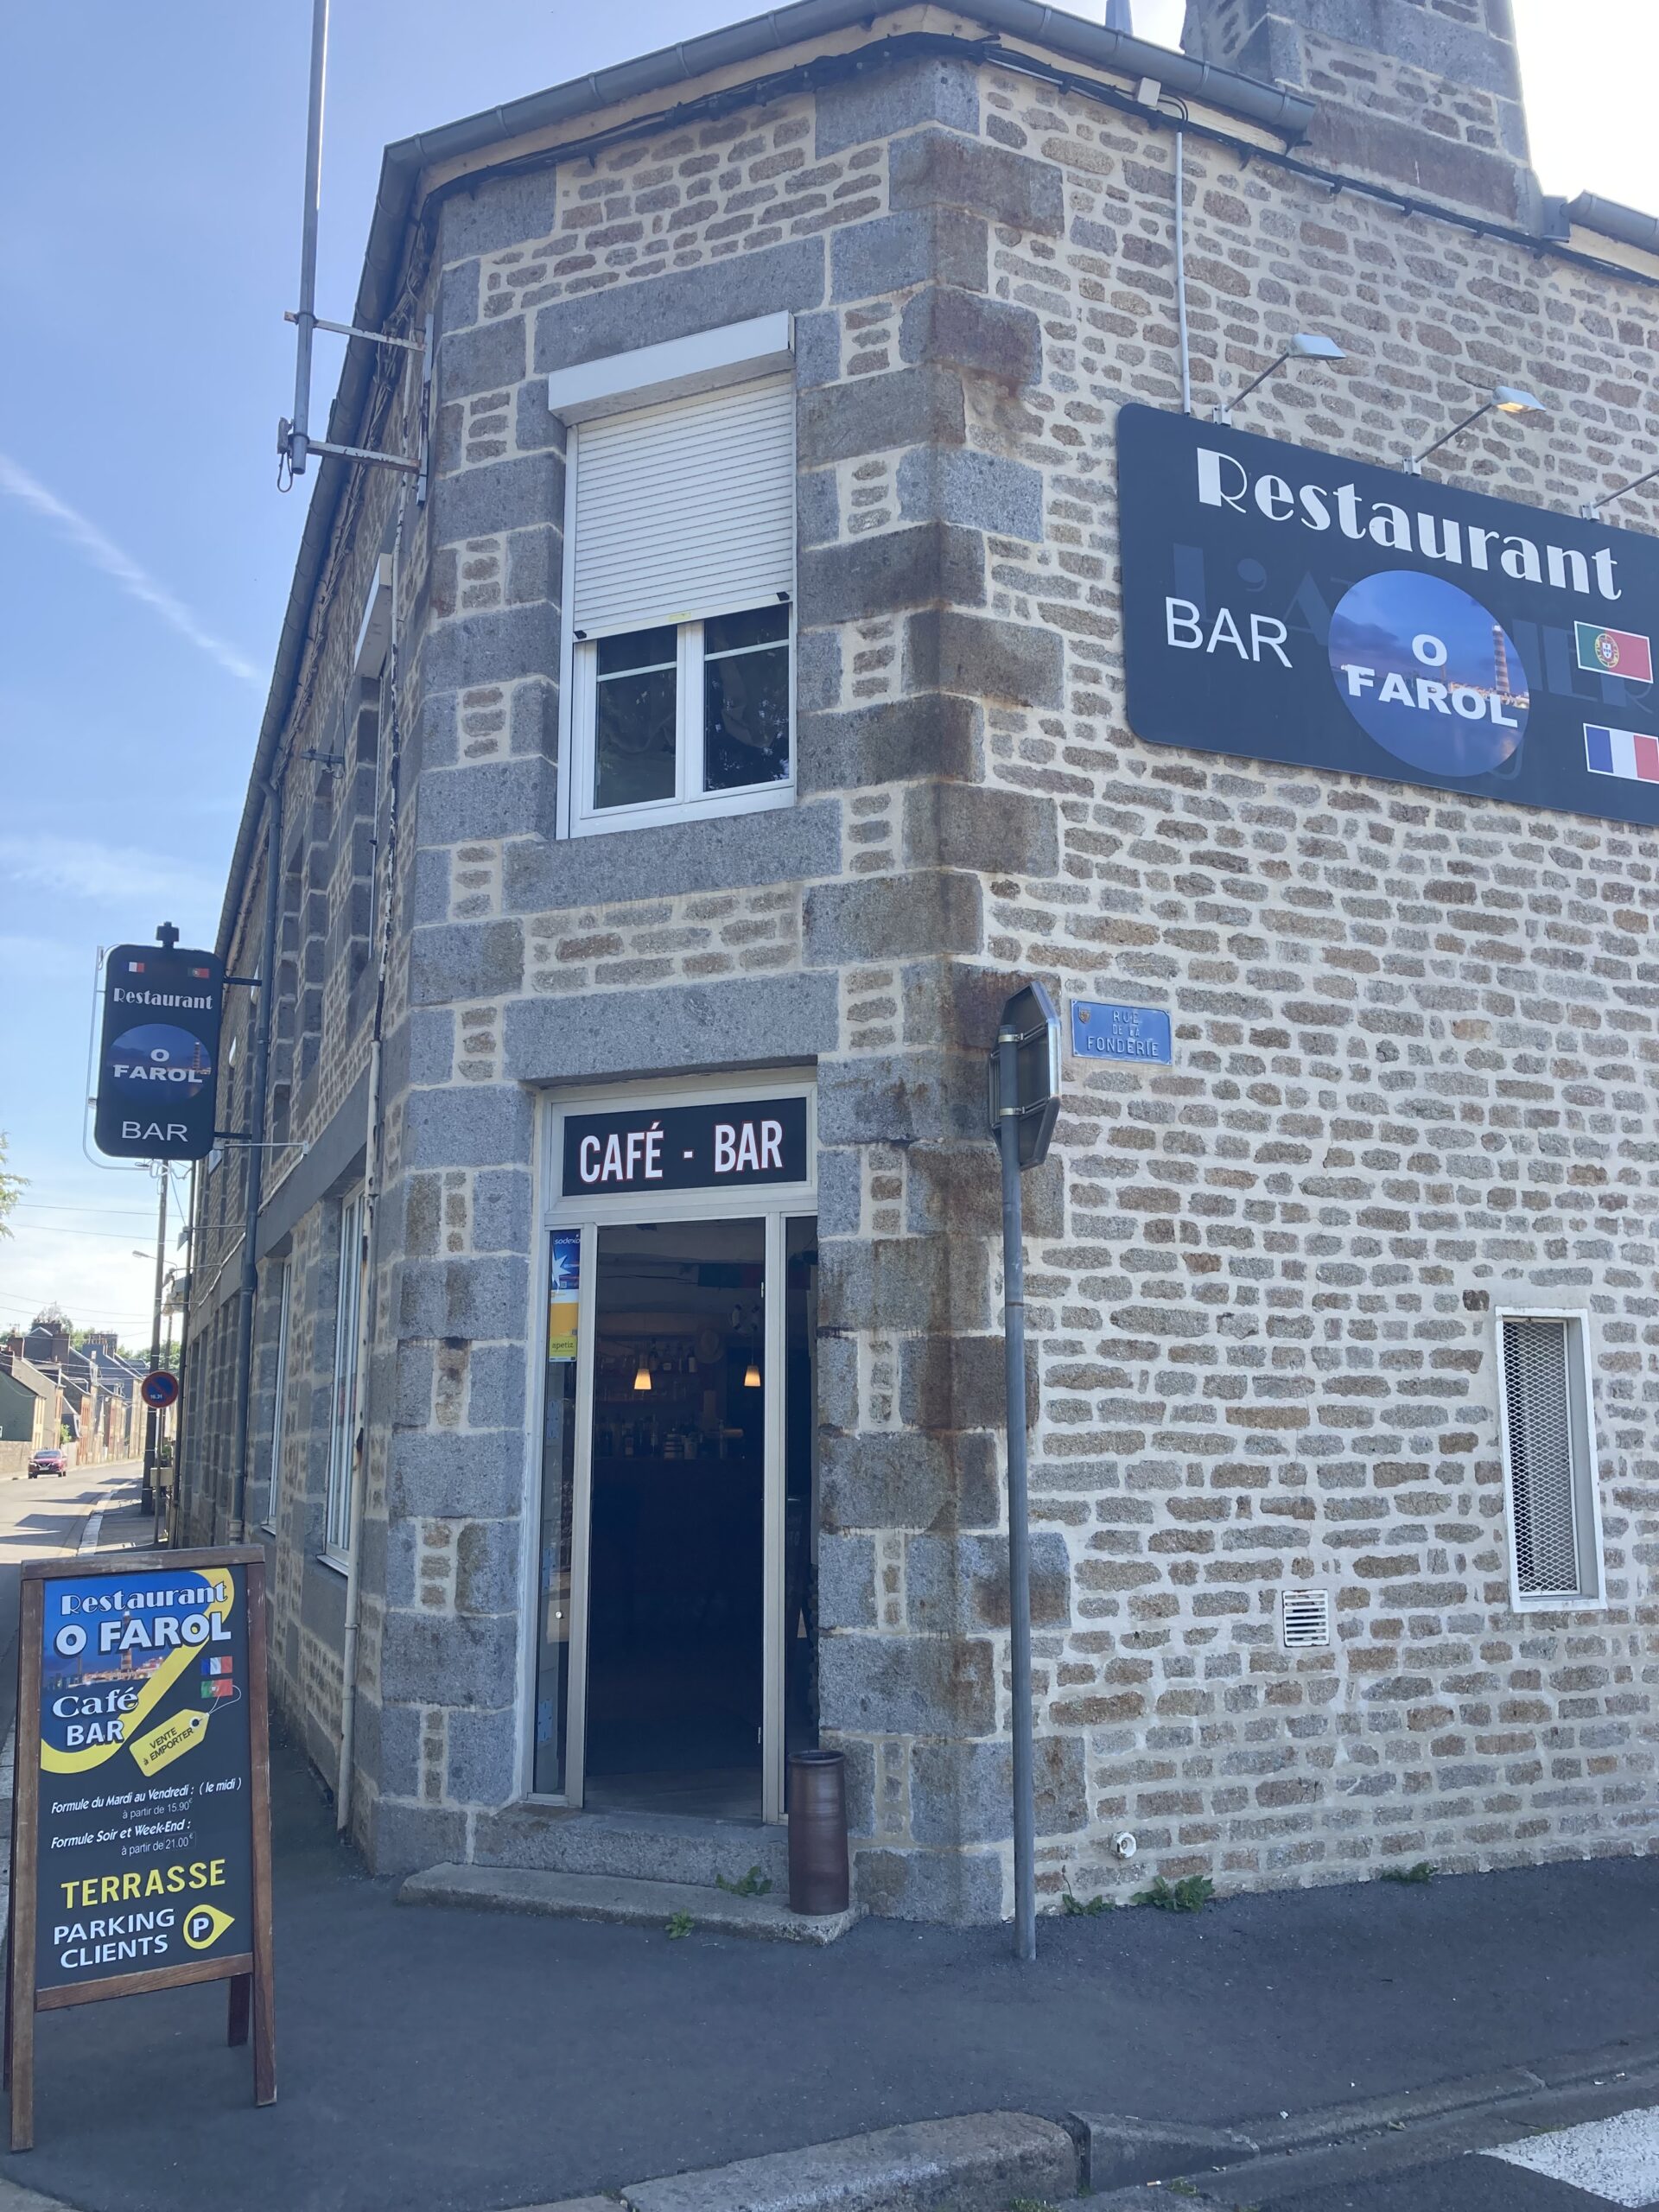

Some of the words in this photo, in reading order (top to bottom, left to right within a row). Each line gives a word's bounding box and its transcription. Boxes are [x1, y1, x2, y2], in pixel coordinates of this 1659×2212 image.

[1197, 447, 1623, 601] Restaurant
[1165, 596, 1294, 668] BAR
[1412, 633, 1448, 667] O
[1345, 664, 1519, 728] FAROL
[113, 988, 213, 1010] Restaurant
[1112, 1024, 1123, 1034] DE
[1113, 1010, 1139, 1025] RUE
[150, 1048, 170, 1062] O
[1087, 1036, 1159, 1057] FONDERIE
[113, 1065, 203, 1083] FAROL
[121, 1121, 188, 1141] BAR
[580, 1122, 664, 1183] CAFÉ
[715, 1120, 783, 1173] BAR
[60, 1581, 228, 1616] Restaurant
[55, 1624, 87, 1656] O
[99, 1611, 232, 1652] FAROL
[52, 1687, 138, 1718] Café
[66, 1719, 124, 1747] BAR
[149, 1727, 177, 1749] VENTE
[149, 1727, 194, 1761] EMPORTER
[51, 1799, 89, 1814] Formule
[91, 1796, 105, 1808] du
[105, 1792, 133, 1807] Mardi
[134, 1793, 146, 1802] au
[148, 1784, 189, 1800] Vendredi
[205, 1781, 214, 1793] le
[216, 1778, 236, 1791] midi
[122, 1809, 128, 1819] à
[130, 1808, 151, 1820] partir
[153, 1806, 164, 1815] de
[51, 1833, 94, 1849] Formule
[96, 1828, 118, 1842] Soir
[119, 1827, 132, 1839] et
[135, 1819, 186, 1836] Week-End
[121, 1845, 127, 1856] à
[129, 1843, 151, 1857] partir
[152, 1841, 164, 1851] de
[60, 1859, 226, 1909] TERRASSE
[54, 1908, 175, 1945] PARKING
[60, 1934, 168, 1968] CLIENTS
